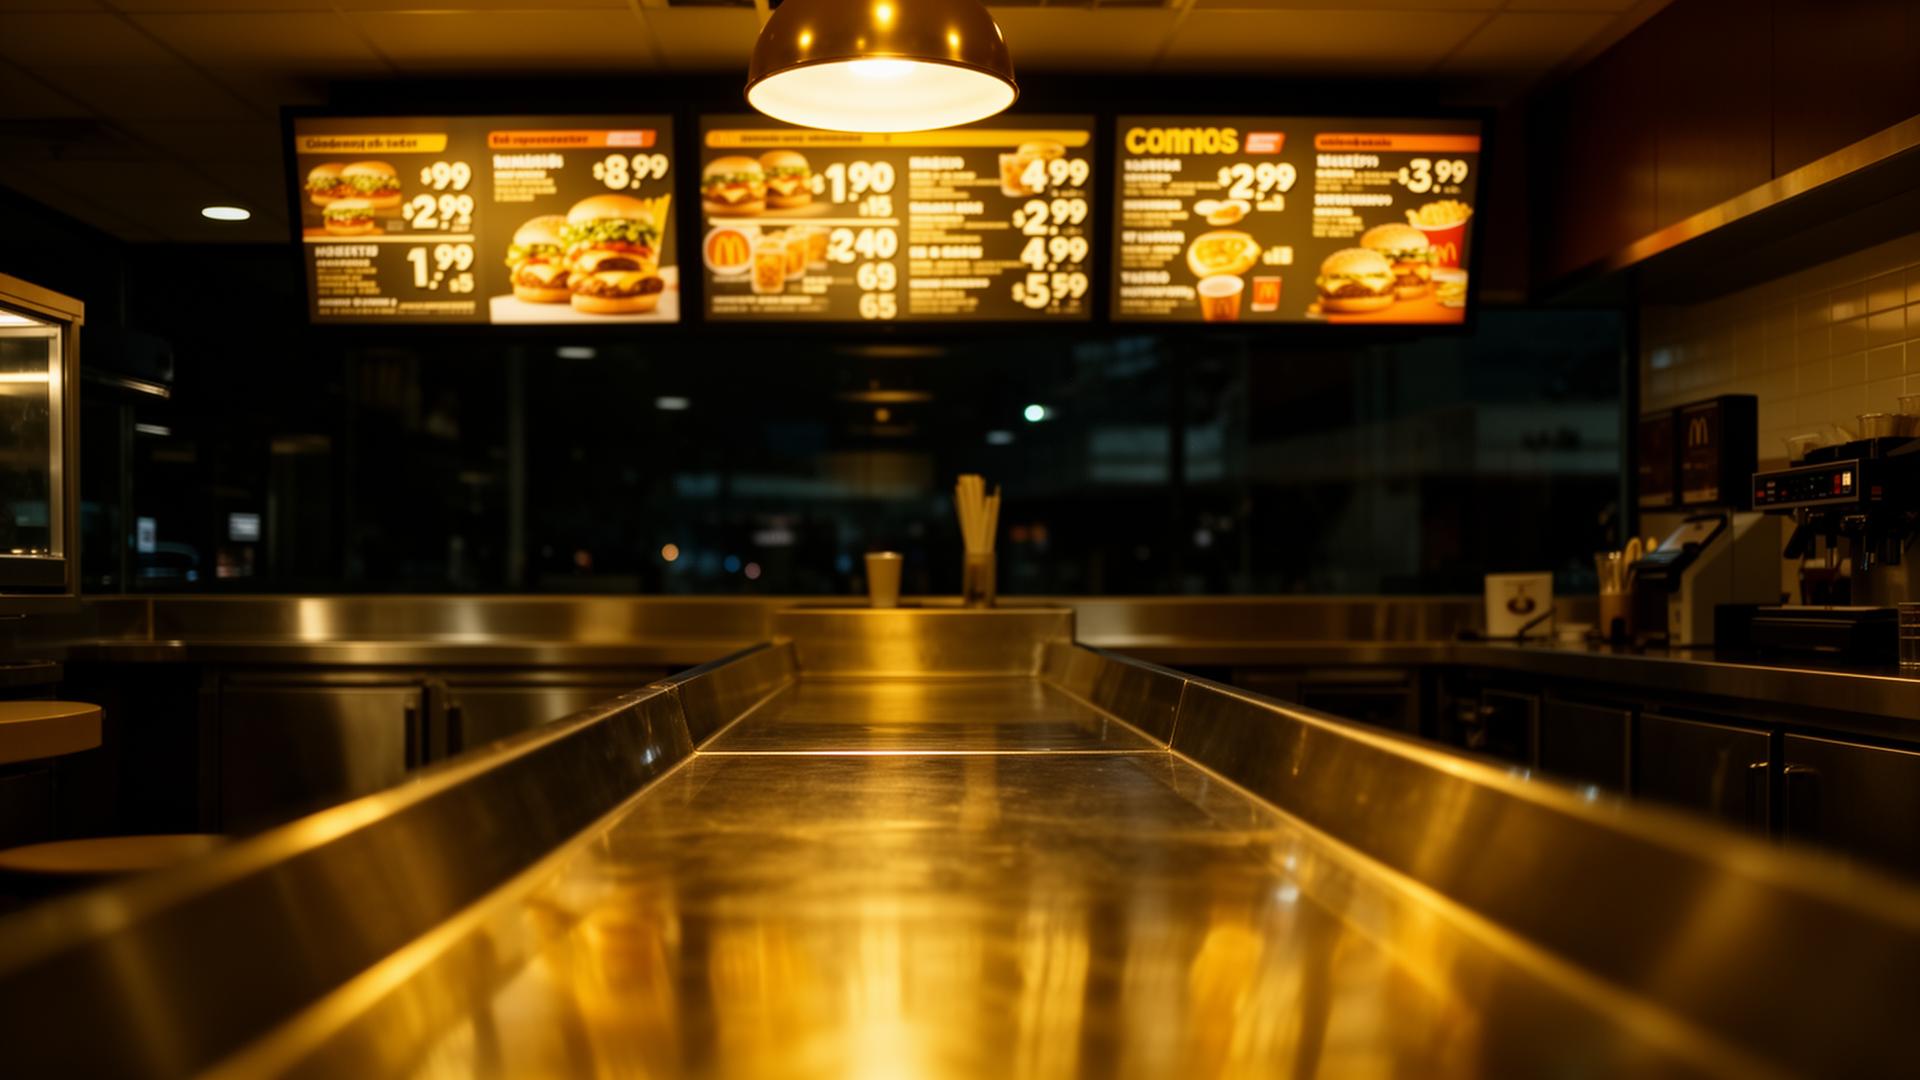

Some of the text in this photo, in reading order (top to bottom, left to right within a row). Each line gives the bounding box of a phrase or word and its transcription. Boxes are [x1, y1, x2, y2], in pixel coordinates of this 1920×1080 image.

[593, 153, 669, 189] $8.99
[811, 160, 895, 203] $1.90
[1397, 158, 1468, 193] $3.99
